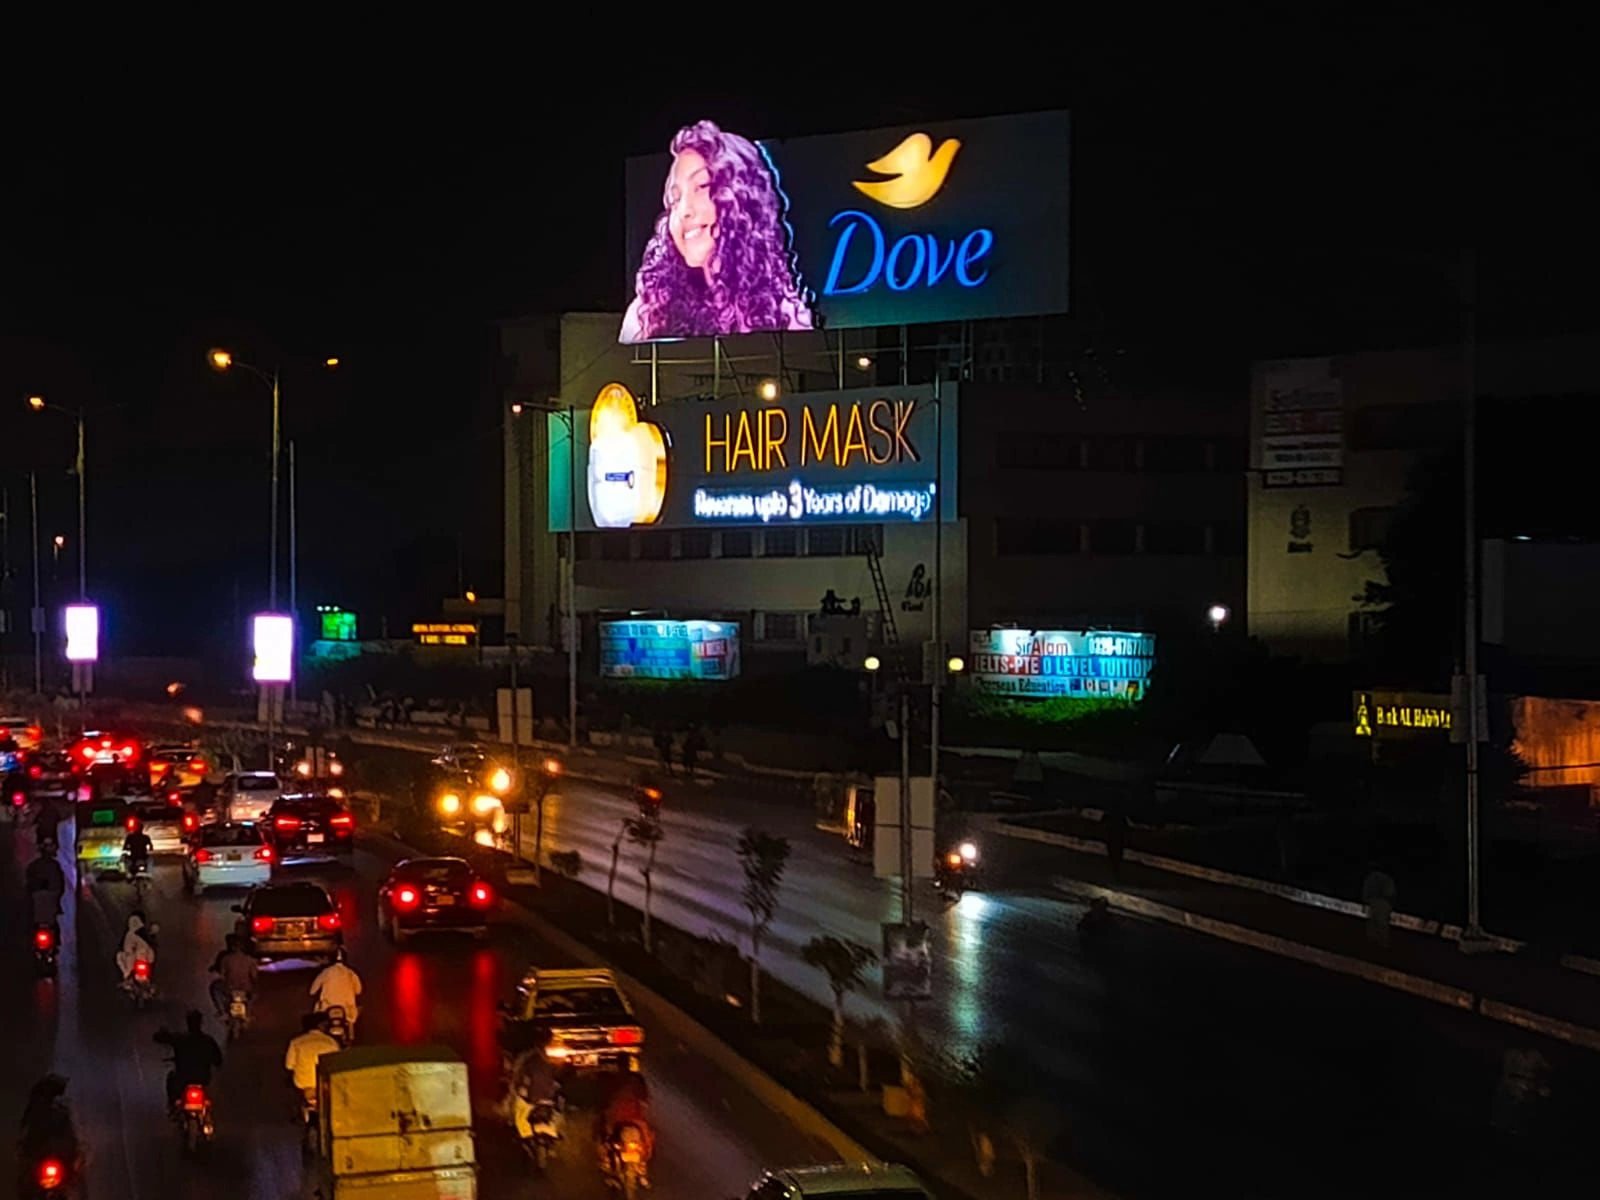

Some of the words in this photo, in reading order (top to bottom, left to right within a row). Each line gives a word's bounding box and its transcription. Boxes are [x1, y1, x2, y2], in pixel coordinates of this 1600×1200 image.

[824, 209, 994, 296] Dove
[705, 409, 788, 473] HAIR
[801, 399, 920, 466] MASK
[789, 480, 803, 519] 3
[845, 485, 862, 513] of
[1056, 658, 1096, 677] LEVEL
